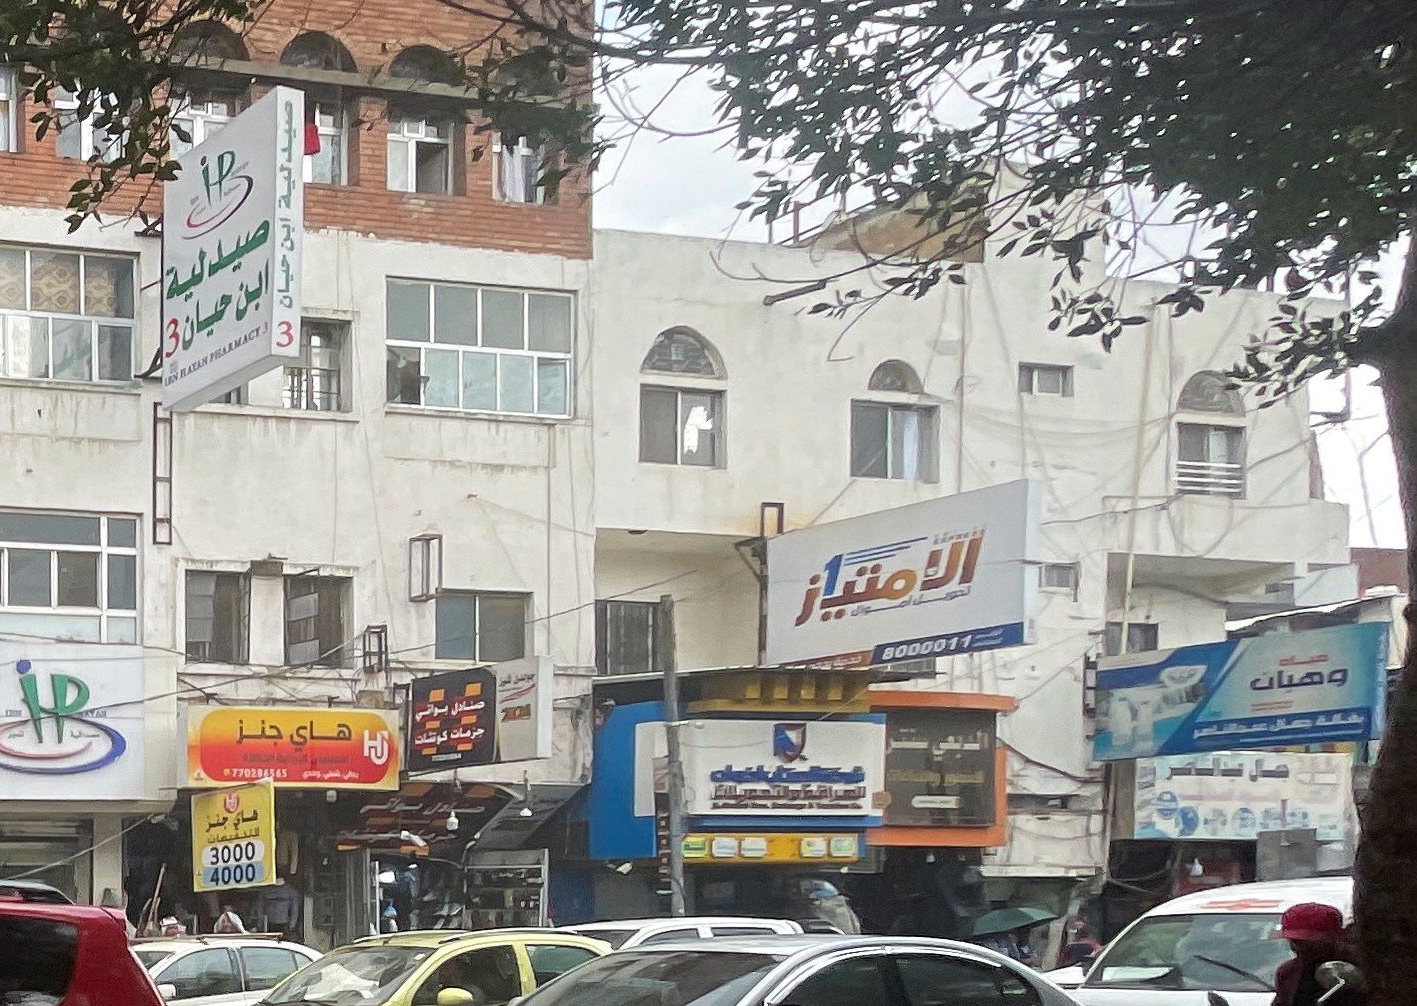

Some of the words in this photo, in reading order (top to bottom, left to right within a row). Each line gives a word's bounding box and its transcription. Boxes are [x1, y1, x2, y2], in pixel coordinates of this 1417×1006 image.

[166, 219, 270, 302] صيدلية
[235, 259, 270, 321] ابن
[182, 293, 233, 352] حيان
[276, 320, 294, 348] 3
[164, 317, 180, 360] 3
[209, 326, 261, 363] PHARMACY
[881, 634, 974, 662] 8000011
[236, 719, 283, 747] جنز
[289, 720, 352, 752] هاي
[363, 729, 389, 766] HJ
[206, 813, 229, 833] جنز
[232, 808, 259, 831] هاي
[209, 841, 256, 866] 3000
[210, 863, 256, 887] 4000
